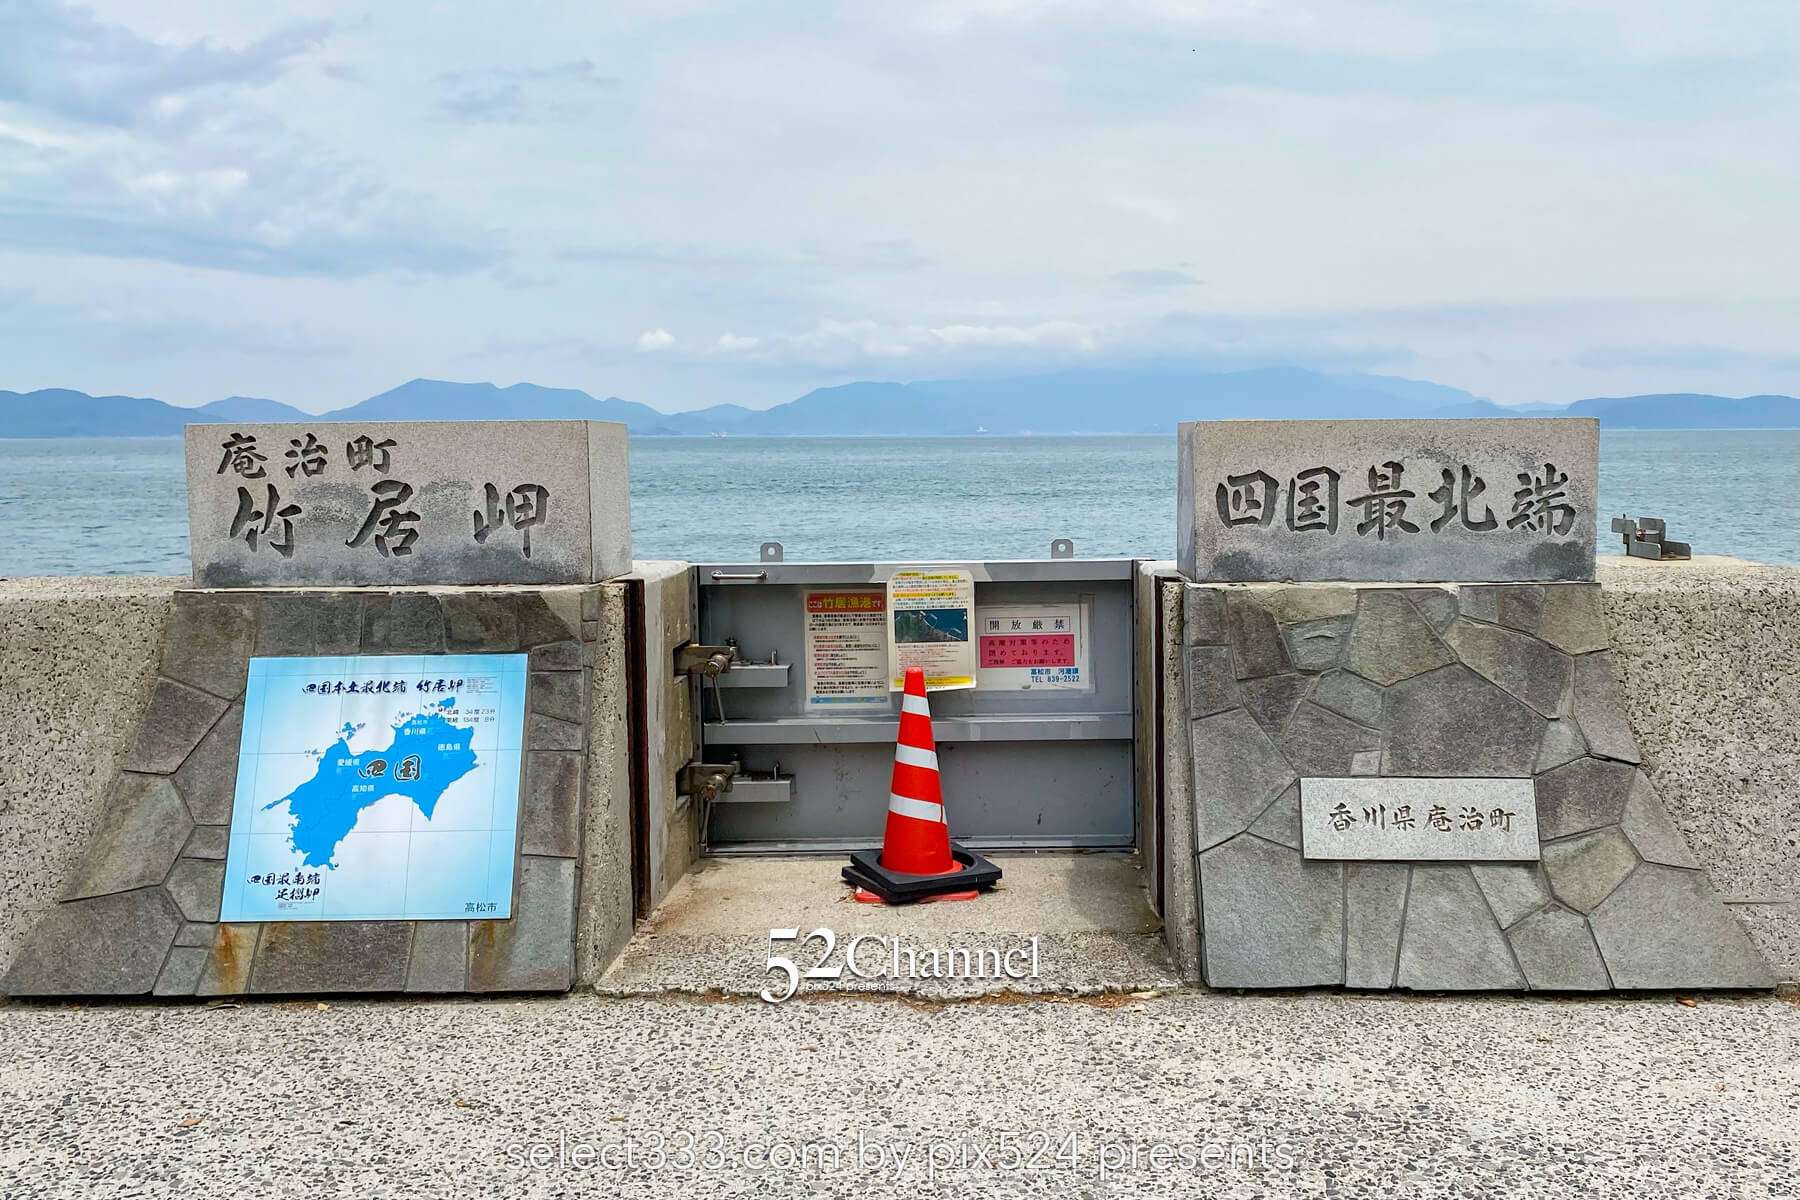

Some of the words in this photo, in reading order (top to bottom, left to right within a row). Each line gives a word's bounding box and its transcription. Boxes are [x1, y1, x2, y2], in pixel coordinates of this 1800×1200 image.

[217, 433, 398, 479] 庵治町
[229, 480, 550, 559] 竹居岬
[1215, 461, 1576, 541] 四国最北端
[1031, 675, 1044, 683] TEL
[1047, 674, 1080, 683] 839-2522
[358, 754, 422, 782] 四国
[464, 901, 498, 912] 高松市
